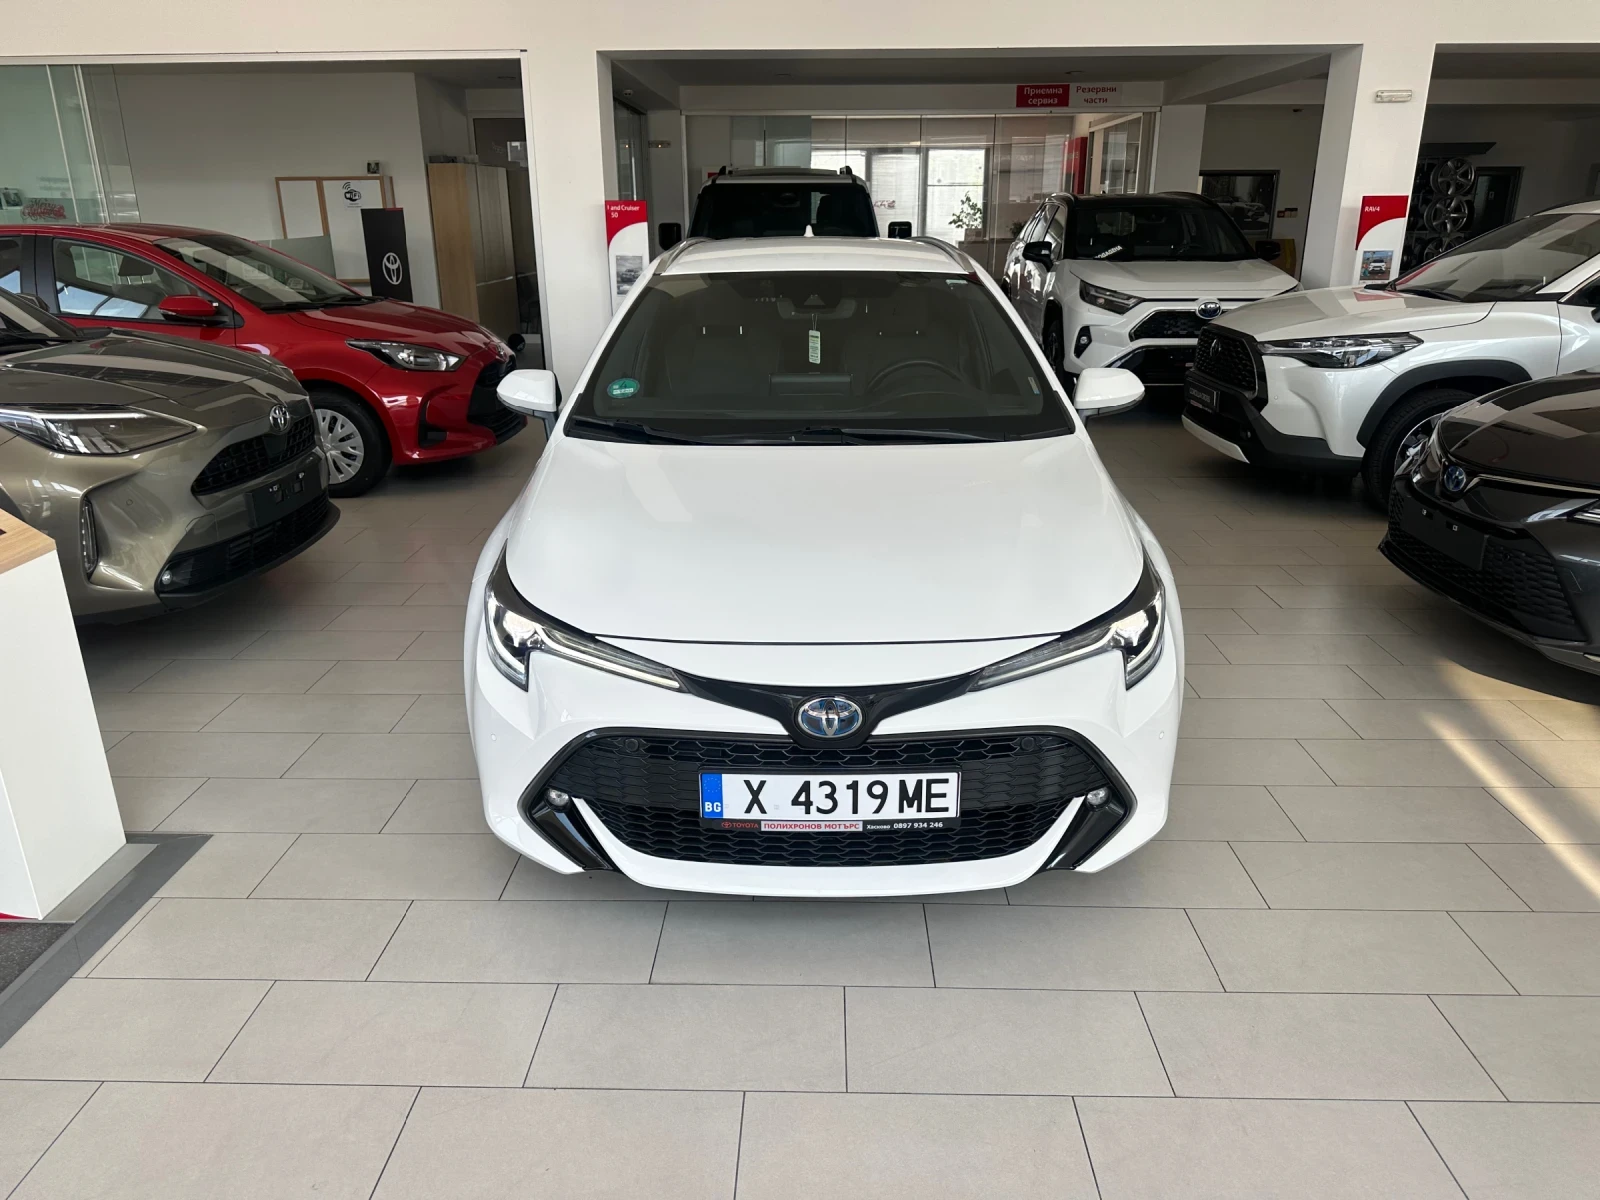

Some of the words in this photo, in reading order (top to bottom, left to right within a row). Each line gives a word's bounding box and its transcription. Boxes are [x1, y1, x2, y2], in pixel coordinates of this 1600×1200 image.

[1024, 87, 1063, 96] Приемна
[1076, 85, 1117, 95] Резервни
[1028, 97, 1058, 106] сервиз
[704, 802, 722, 812] BG
